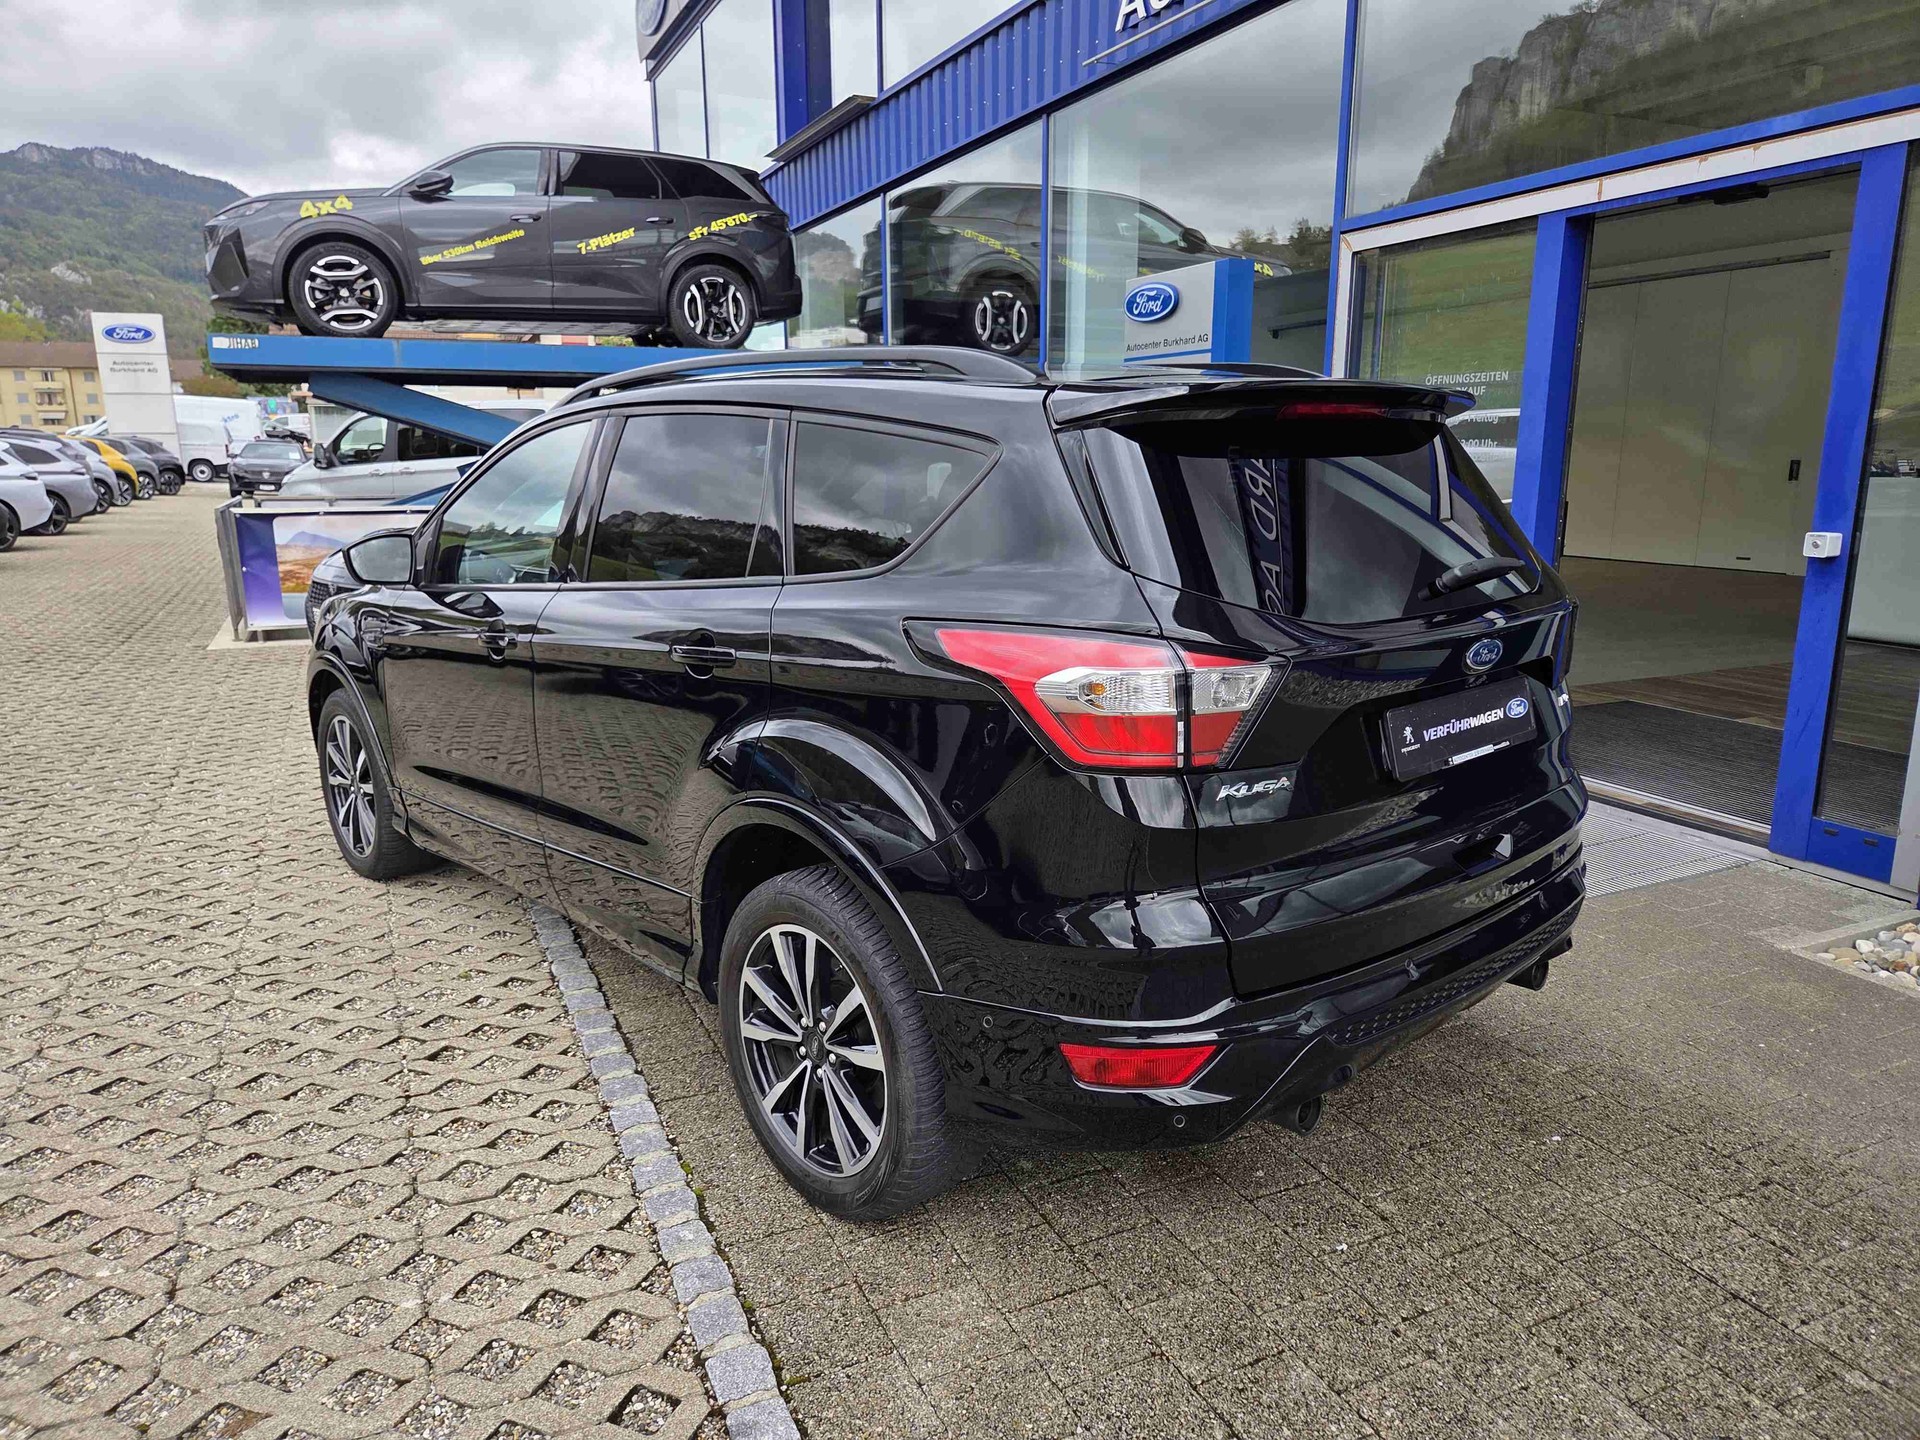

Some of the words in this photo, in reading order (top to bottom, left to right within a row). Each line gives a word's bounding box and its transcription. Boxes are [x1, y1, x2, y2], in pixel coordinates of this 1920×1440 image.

[300, 194, 353, 218] 4x4
[475, 229, 525, 250] Reichweite
[577, 227, 636, 254] 7-Plätzer
[688, 225, 709, 241] sFr
[1133, 290, 1165, 315] Ford
[112, 327, 145, 340] Ford
[1126, 341, 1162, 353] Autocenter
[1163, 335, 1196, 348] Burkhard
[1197, 333, 1209, 344] AG
[1425, 371, 1509, 386] ÖFFNUNGSZEITEN
[1482, 438, 1498, 448] Uhr
[1423, 707, 1504, 741] VERFÜHRWAGEN
[1509, 700, 1525, 716] Ford
[1216, 776, 1294, 802] KUGA
